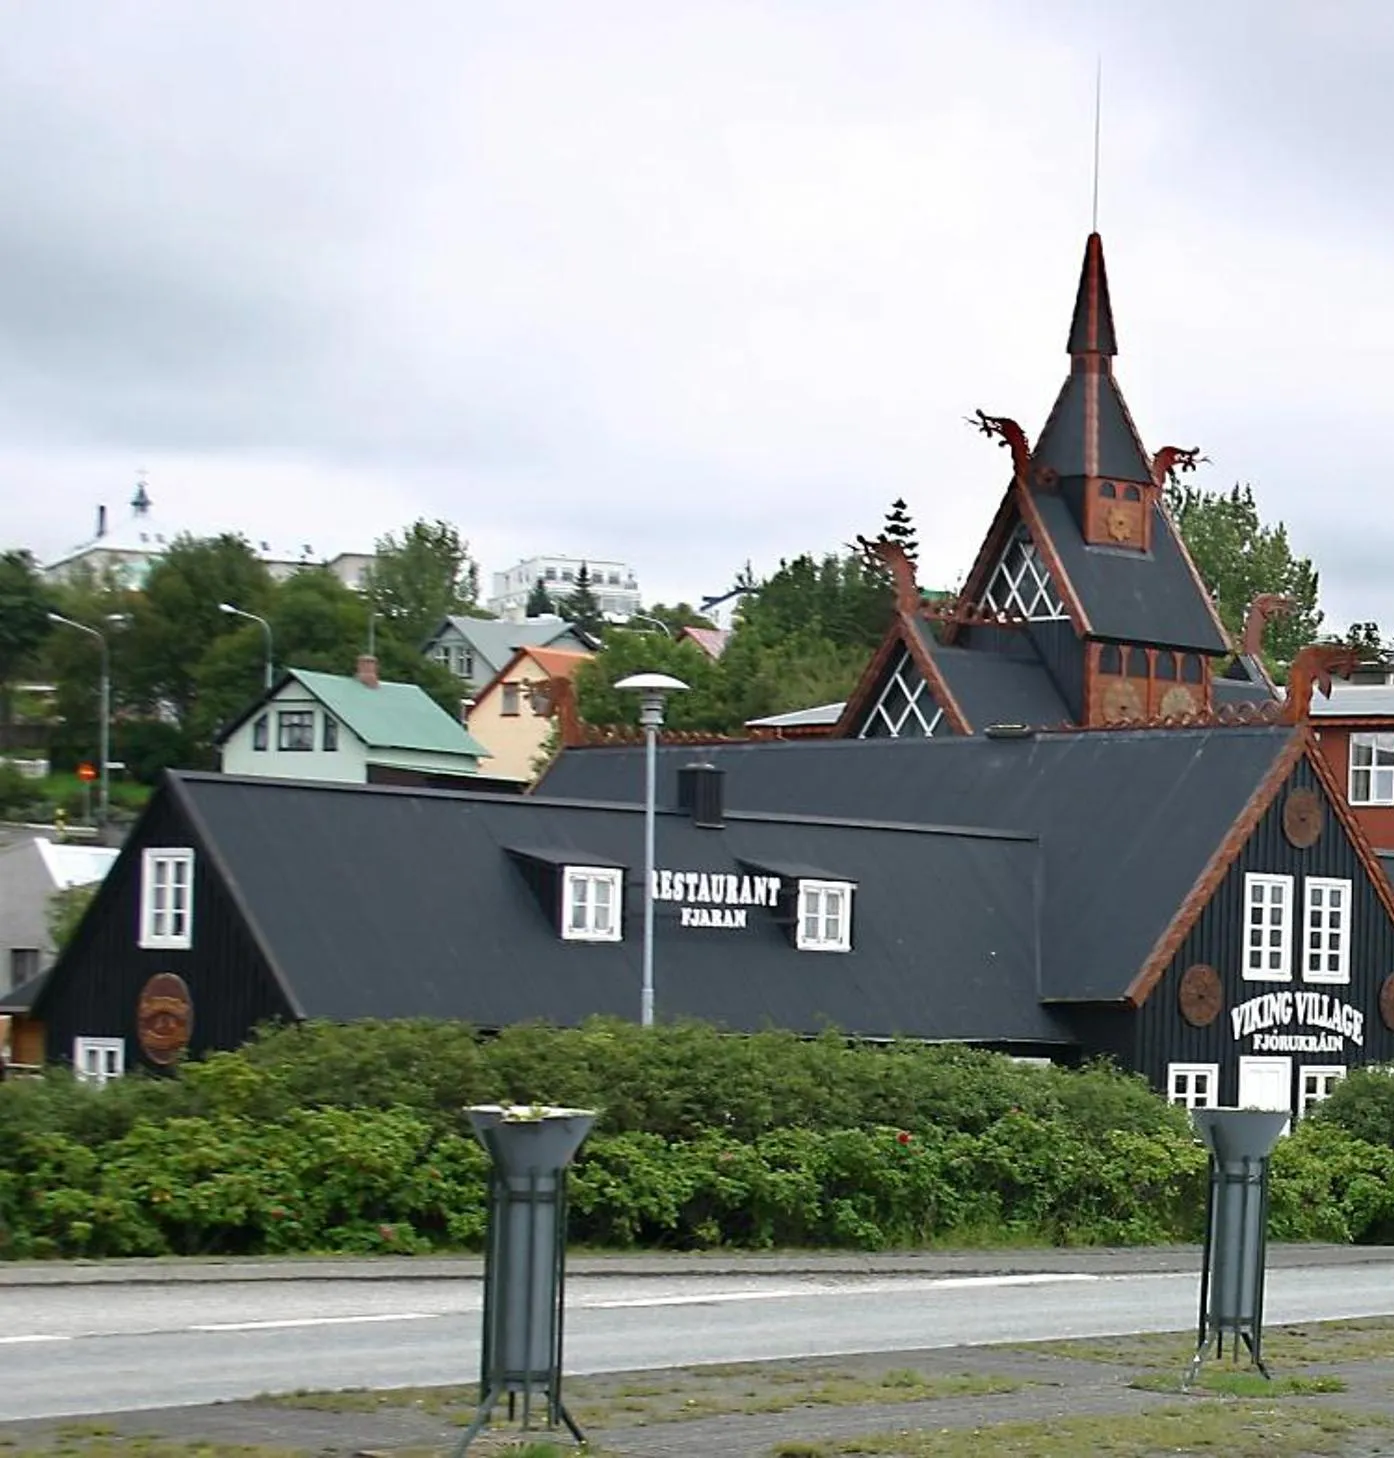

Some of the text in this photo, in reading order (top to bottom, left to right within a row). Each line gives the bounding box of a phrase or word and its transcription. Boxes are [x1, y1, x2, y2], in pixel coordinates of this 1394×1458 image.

[681, 907, 747, 928] FJARAN
[1231, 991, 1363, 1046] VIKING VILLAGE
